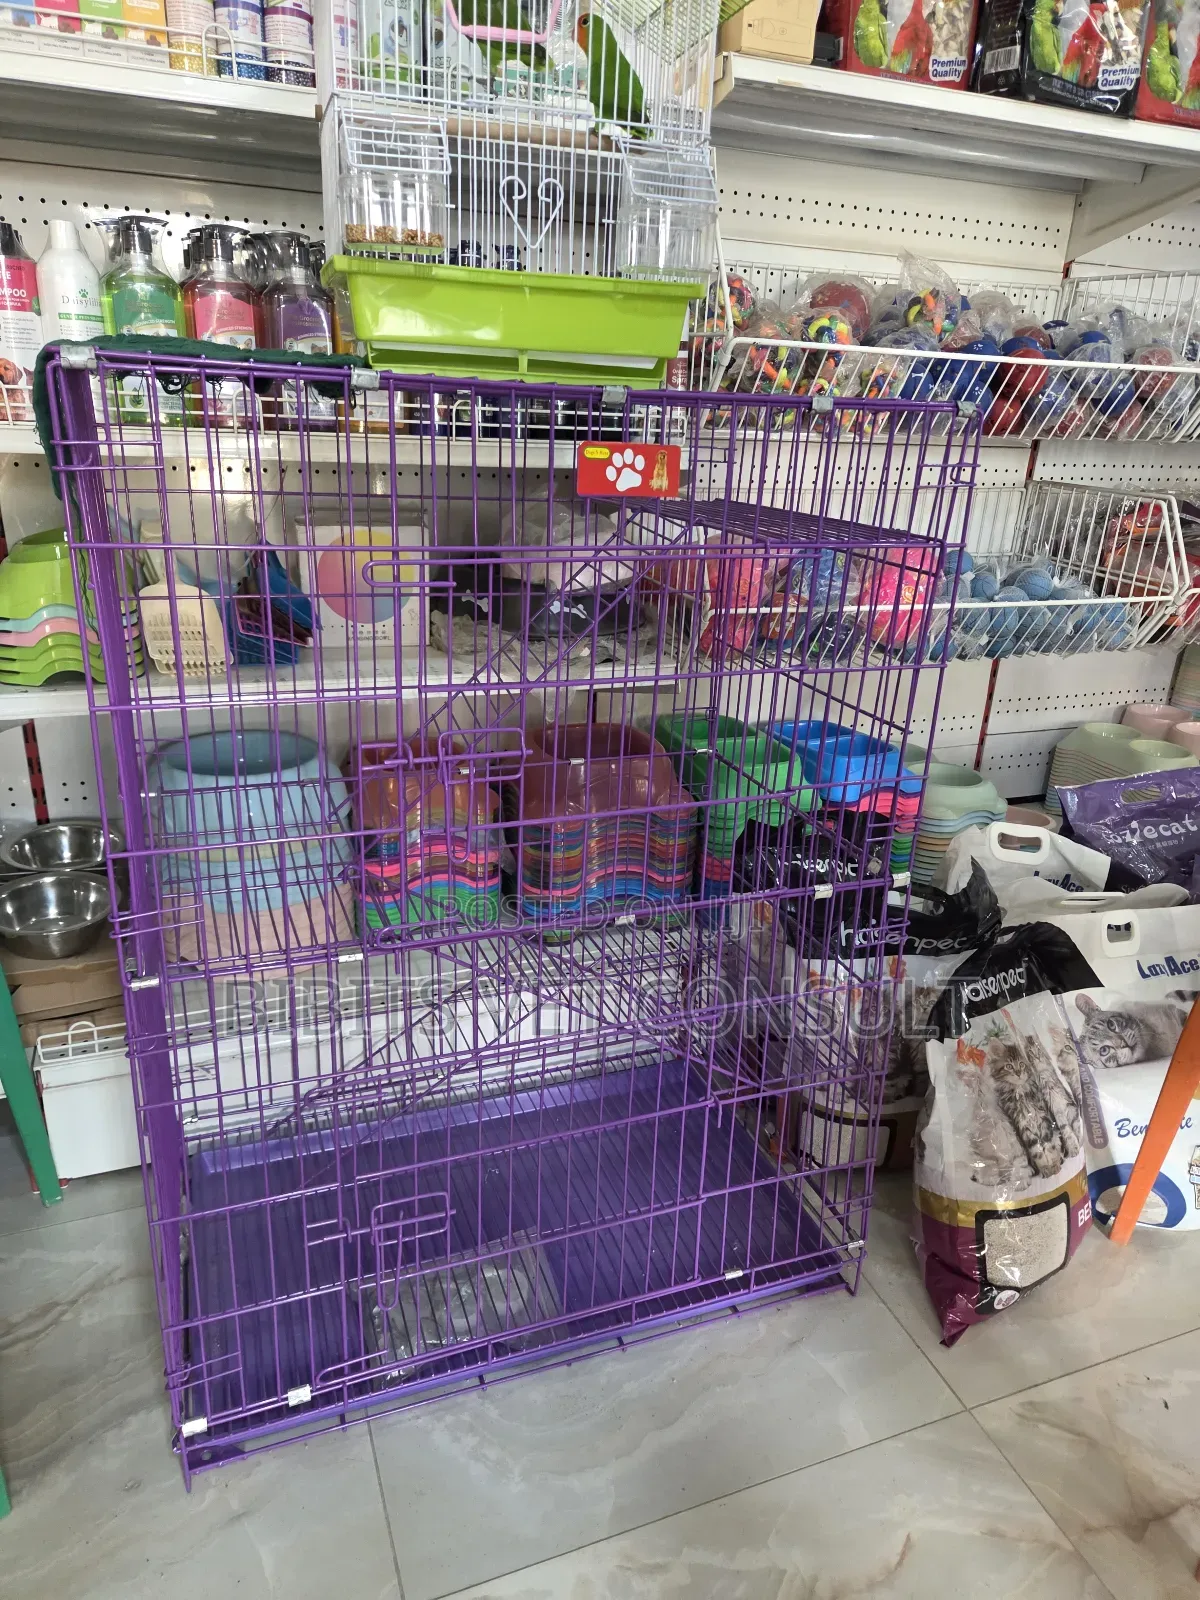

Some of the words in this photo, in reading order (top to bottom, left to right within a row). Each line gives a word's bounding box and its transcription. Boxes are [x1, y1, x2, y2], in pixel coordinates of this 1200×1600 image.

[931, 57, 967, 69] Premium
[931, 67, 962, 79] Quality
[1101, 65, 1140, 77] Premium
[1101, 74, 1135, 87] Quality
